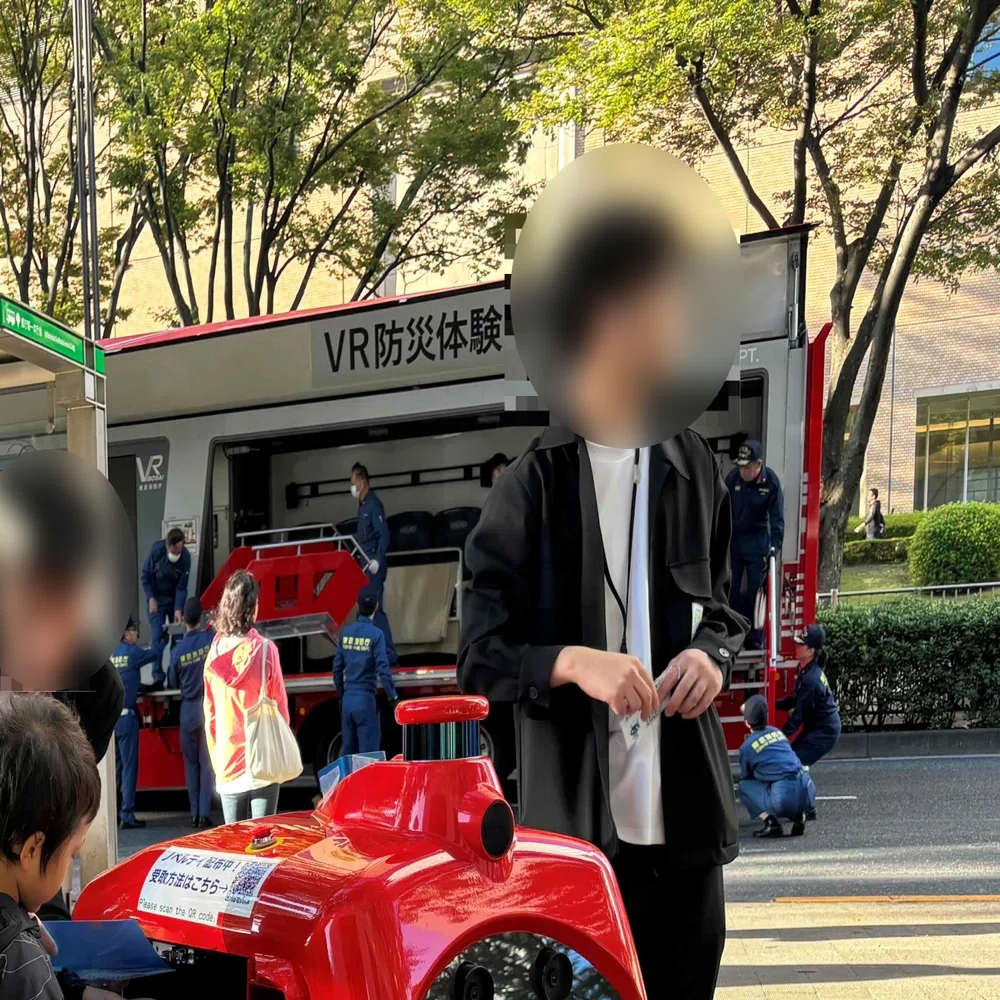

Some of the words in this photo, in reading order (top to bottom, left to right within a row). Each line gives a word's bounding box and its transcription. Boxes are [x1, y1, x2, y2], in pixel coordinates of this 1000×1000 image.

[323, 304, 504, 373] VR防災体験
[740, 347, 760, 363] PT.
[139, 897, 158, 911] Please
[159, 904, 173, 914] scan
[175, 906, 186, 917] the
[188, 907, 197, 919] QR
